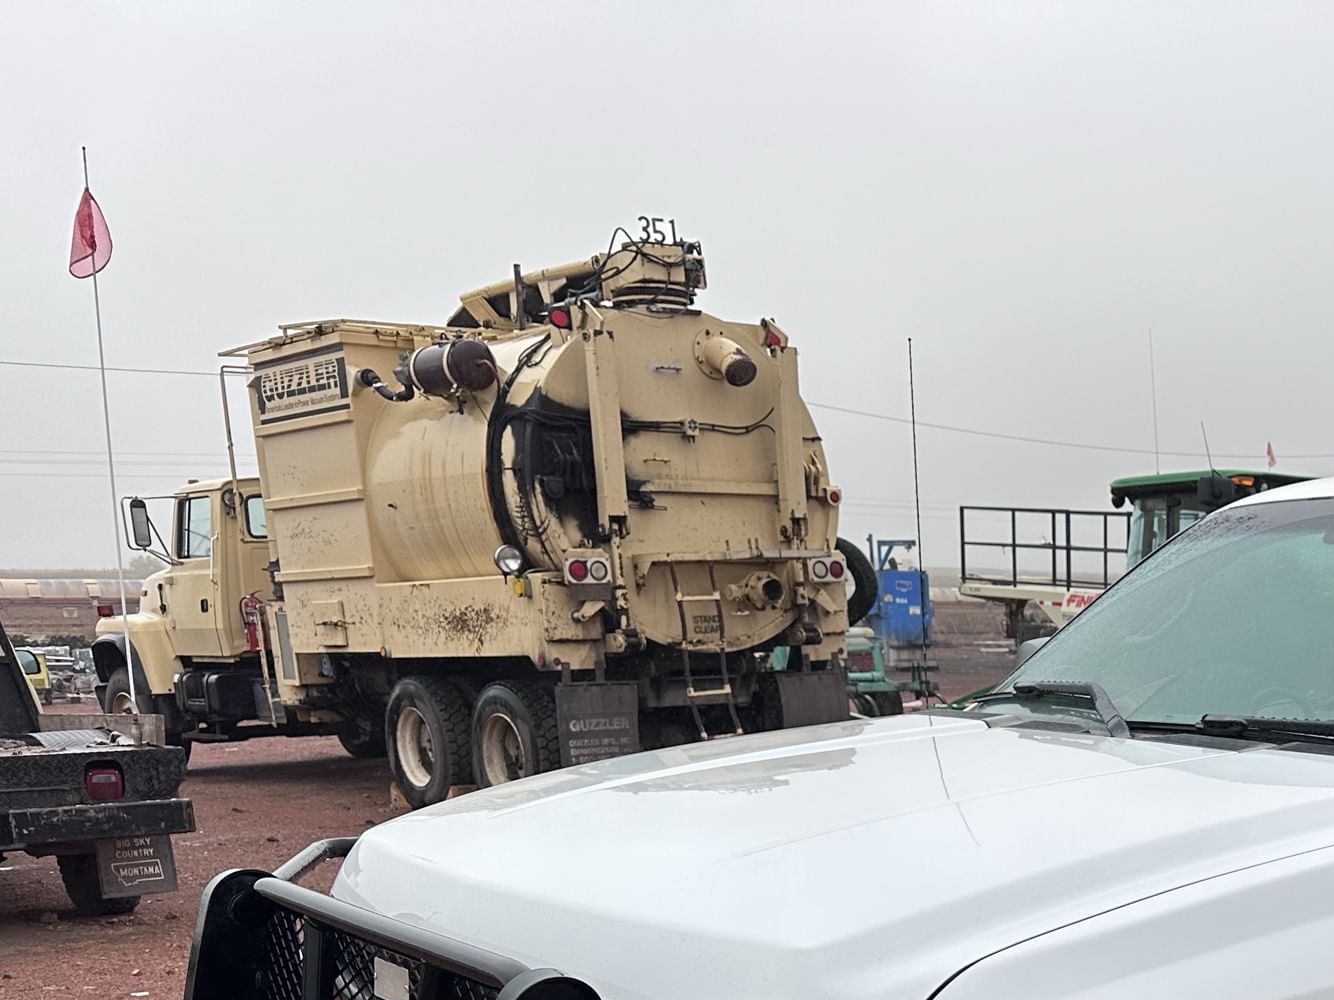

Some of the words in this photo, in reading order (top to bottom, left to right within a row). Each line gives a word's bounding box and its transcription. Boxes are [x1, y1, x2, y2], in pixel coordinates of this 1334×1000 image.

[637, 215, 678, 243] 351
[262, 359, 338, 402] GUZZLER
[569, 717, 630, 732] GUZZLER
[133, 837, 151, 847] SKY
[115, 848, 154, 859] COUNTRY
[119, 865, 160, 877] MONTANA
